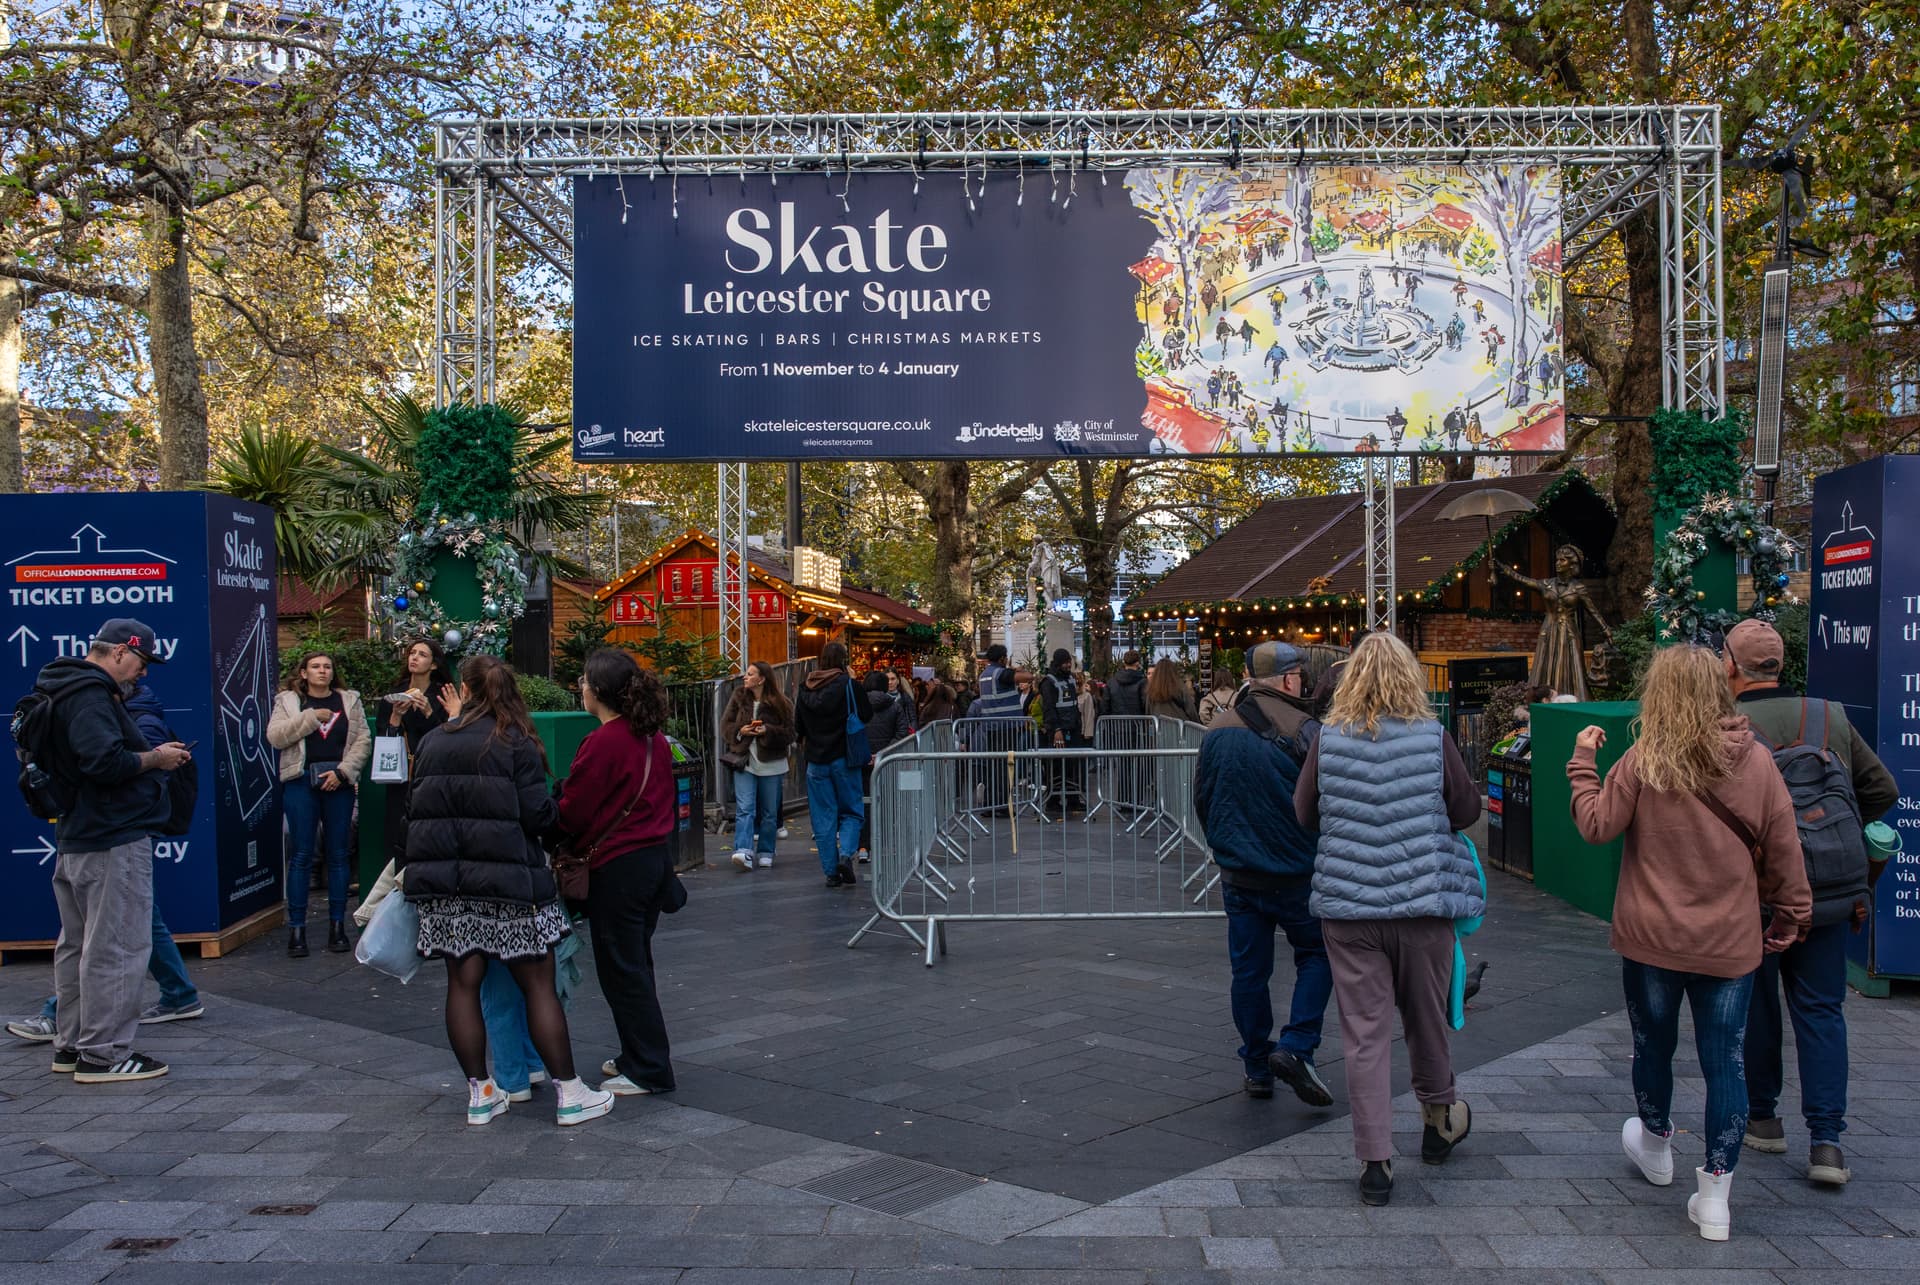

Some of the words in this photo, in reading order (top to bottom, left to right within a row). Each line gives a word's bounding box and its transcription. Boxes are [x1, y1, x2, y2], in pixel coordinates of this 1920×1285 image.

[726, 202, 948, 275] Skate
[684, 281, 850, 314] Leicester
[862, 281, 991, 320] Square
[633, 335, 662, 347] ICE
[672, 334, 749, 346] SKATING
[776, 333, 821, 346] BARS
[848, 332, 951, 345] CHRISTMAS
[961, 331, 1041, 344] MARKETS
[720, 363, 757, 377] From
[761, 362, 769, 376] 1
[773, 362, 854, 376] November
[858, 362, 874, 375] to
[878, 362, 889, 375] 4
[894, 361, 960, 378] January
[624, 427, 665, 443] heart
[744, 418, 932, 434] skateleicestersquare.co.uk
[1084, 419, 1101, 432] City
[1104, 419, 1114, 430] of
[1084, 432, 1139, 442] Westminster
[224, 529, 263, 571] Skate
[23, 567, 160, 578] OFFICIALLONDONTHEATRE.COM
[217, 568, 249, 588] Leicester
[249, 572, 270, 593] Square
[1821, 569, 1845, 590] TICKET
[1846, 565, 1872, 588] BOOTH
[9, 587, 85, 606] TICKET
[91, 585, 174, 605] BOOTH
[1833, 620, 1850, 644] This
[1852, 626, 1871, 650] way
[52, 634, 96, 657] Thi
[154, 841, 189, 863] ay
[1896, 869, 1916, 882] via
[1896, 890, 1911, 900] or
